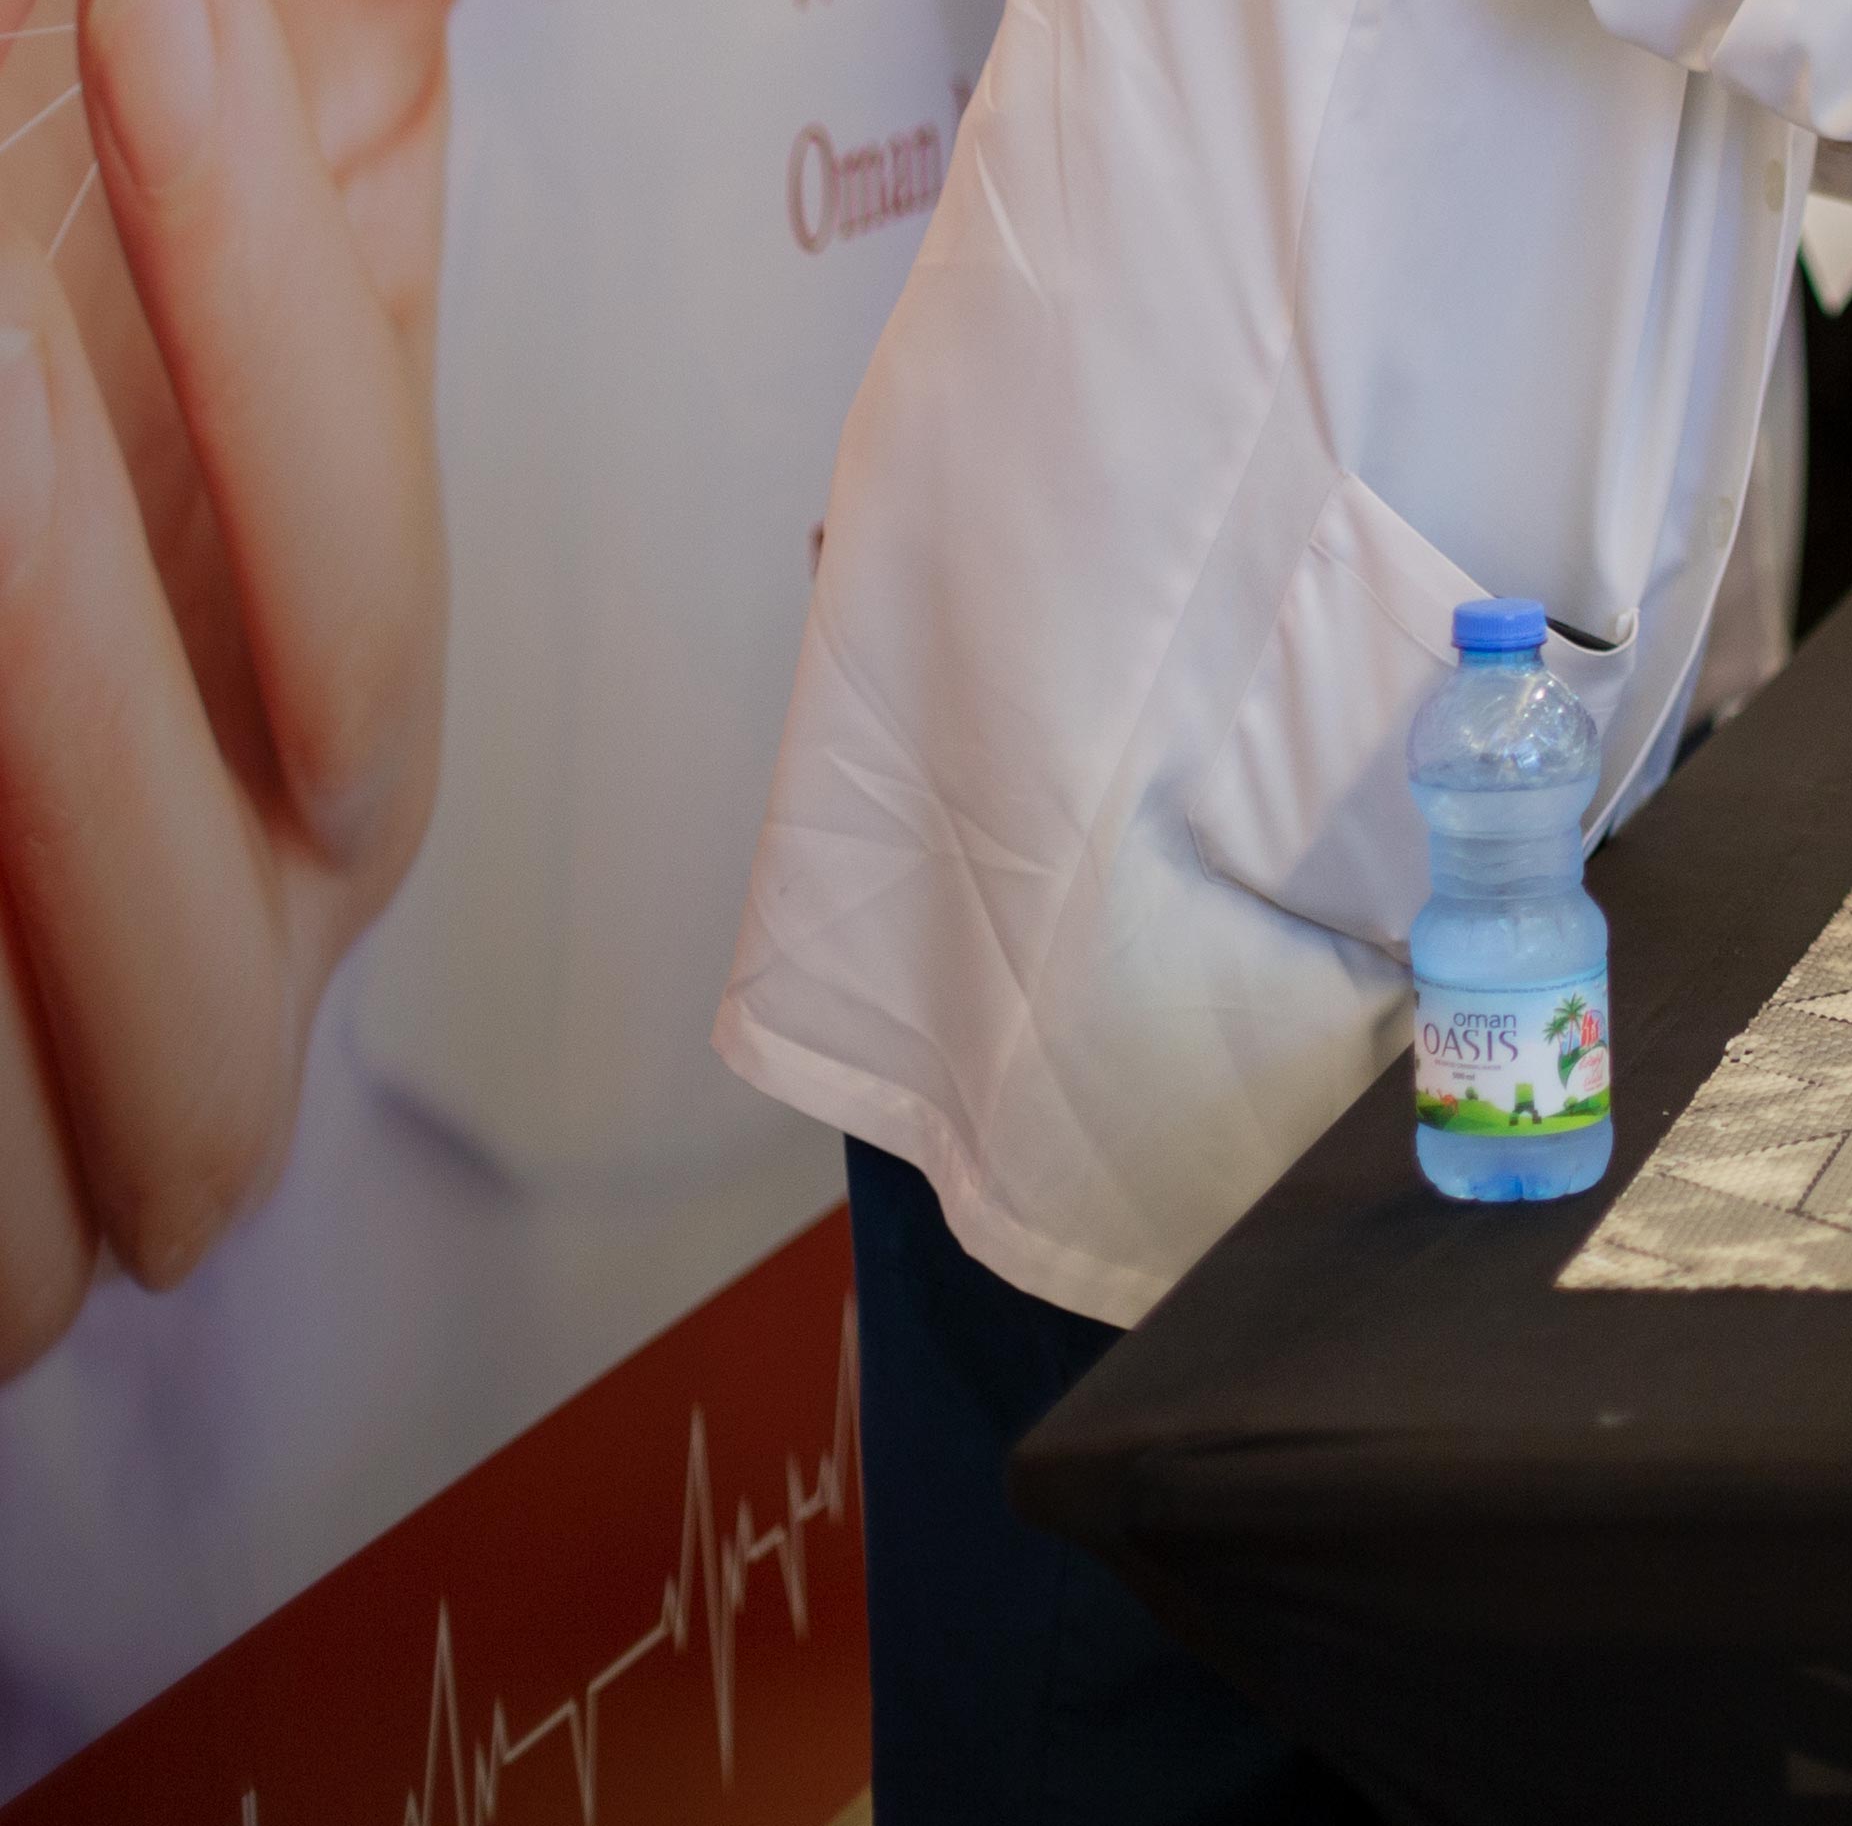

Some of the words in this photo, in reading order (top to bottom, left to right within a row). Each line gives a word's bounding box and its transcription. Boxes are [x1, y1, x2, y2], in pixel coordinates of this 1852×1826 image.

[787, 124, 942, 254] Oman
[1453, 1012, 1517, 1029] oman
[1423, 1022, 1519, 1062] OASIS
